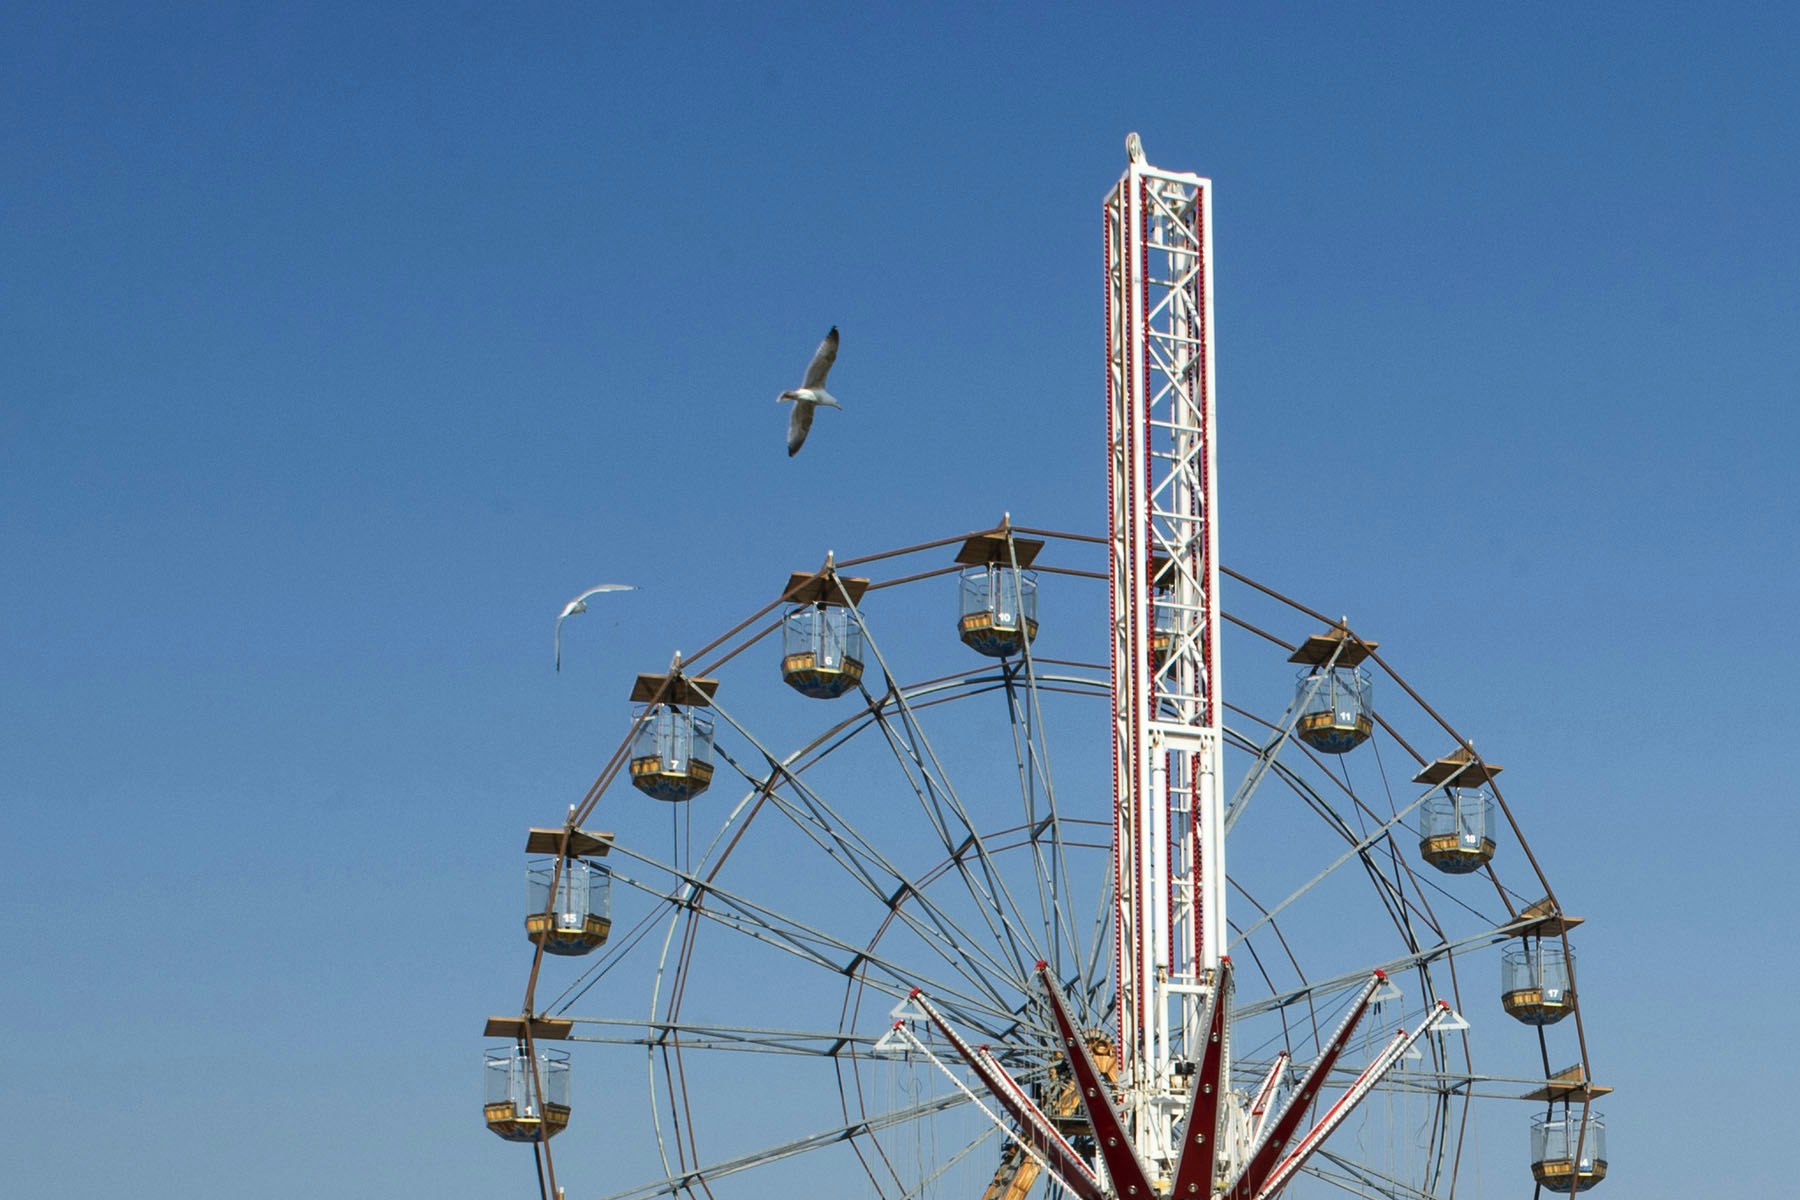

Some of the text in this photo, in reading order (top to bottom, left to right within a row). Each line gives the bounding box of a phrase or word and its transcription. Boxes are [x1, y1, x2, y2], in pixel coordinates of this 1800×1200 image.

[998, 613, 1011, 622] 10
[824, 656, 833, 665] 6
[1340, 711, 1351, 721] 11
[670, 760, 679, 770] 7
[1548, 989, 1559, 998] 17
